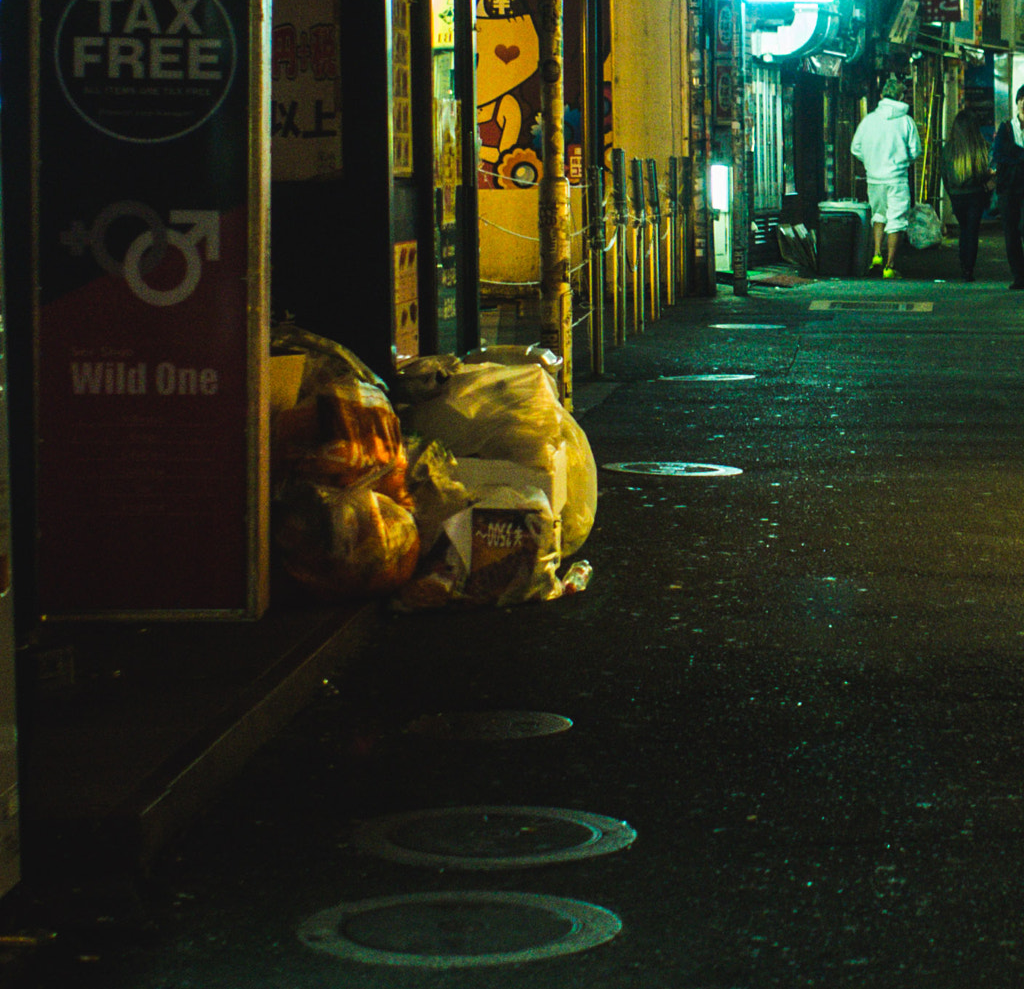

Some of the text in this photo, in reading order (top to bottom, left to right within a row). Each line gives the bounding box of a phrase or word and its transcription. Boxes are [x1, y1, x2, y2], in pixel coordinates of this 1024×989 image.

[73, 37, 223, 81] FREE
[70, 361, 218, 397] Wild One
